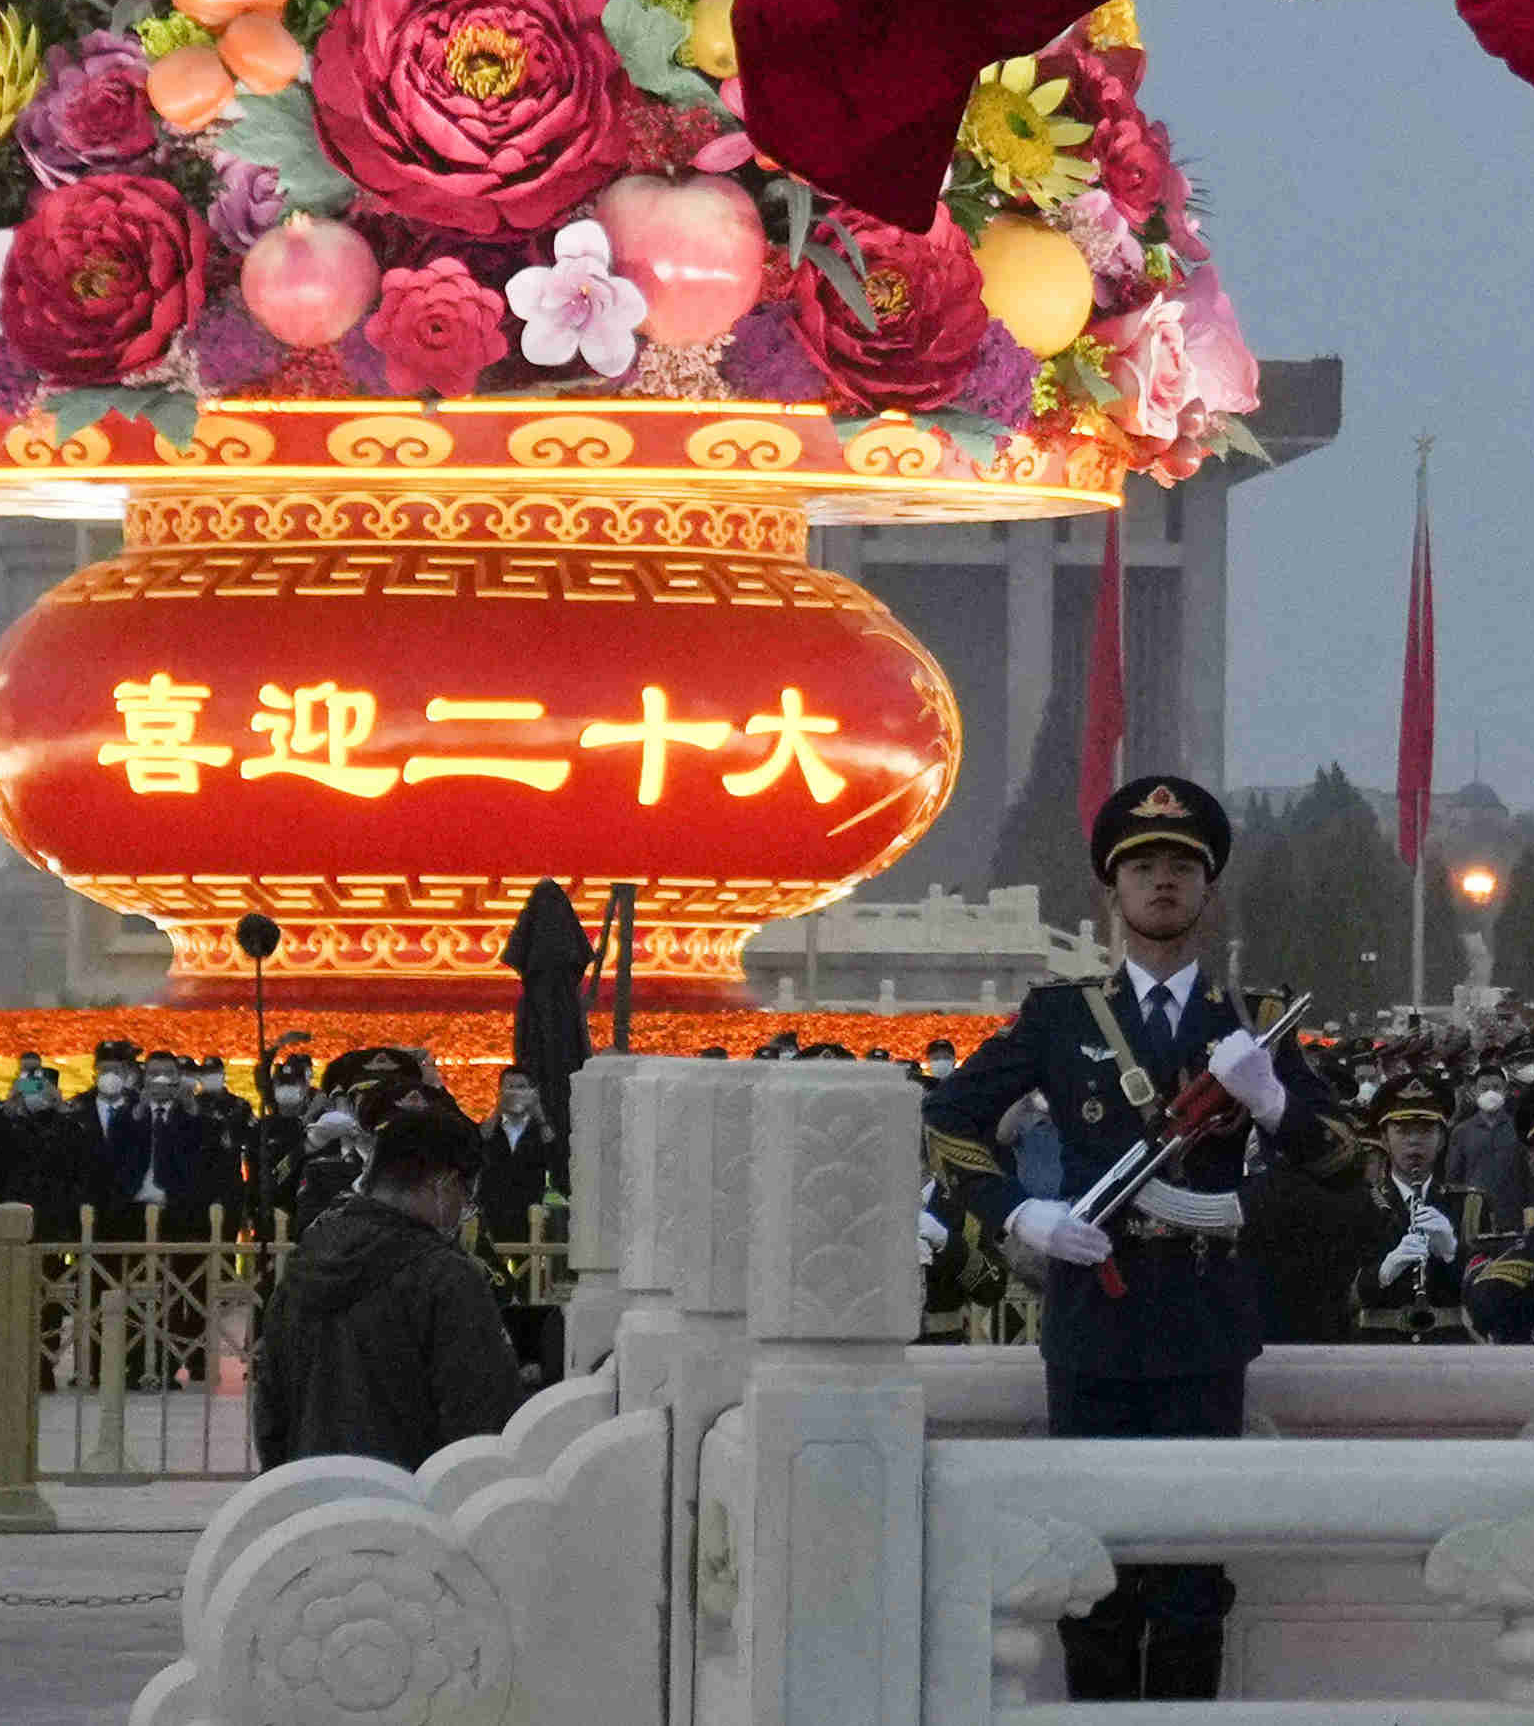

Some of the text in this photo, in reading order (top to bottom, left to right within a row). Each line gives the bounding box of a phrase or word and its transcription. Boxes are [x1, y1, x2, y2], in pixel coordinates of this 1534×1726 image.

[97, 672, 847, 806] 喜迎二十大
